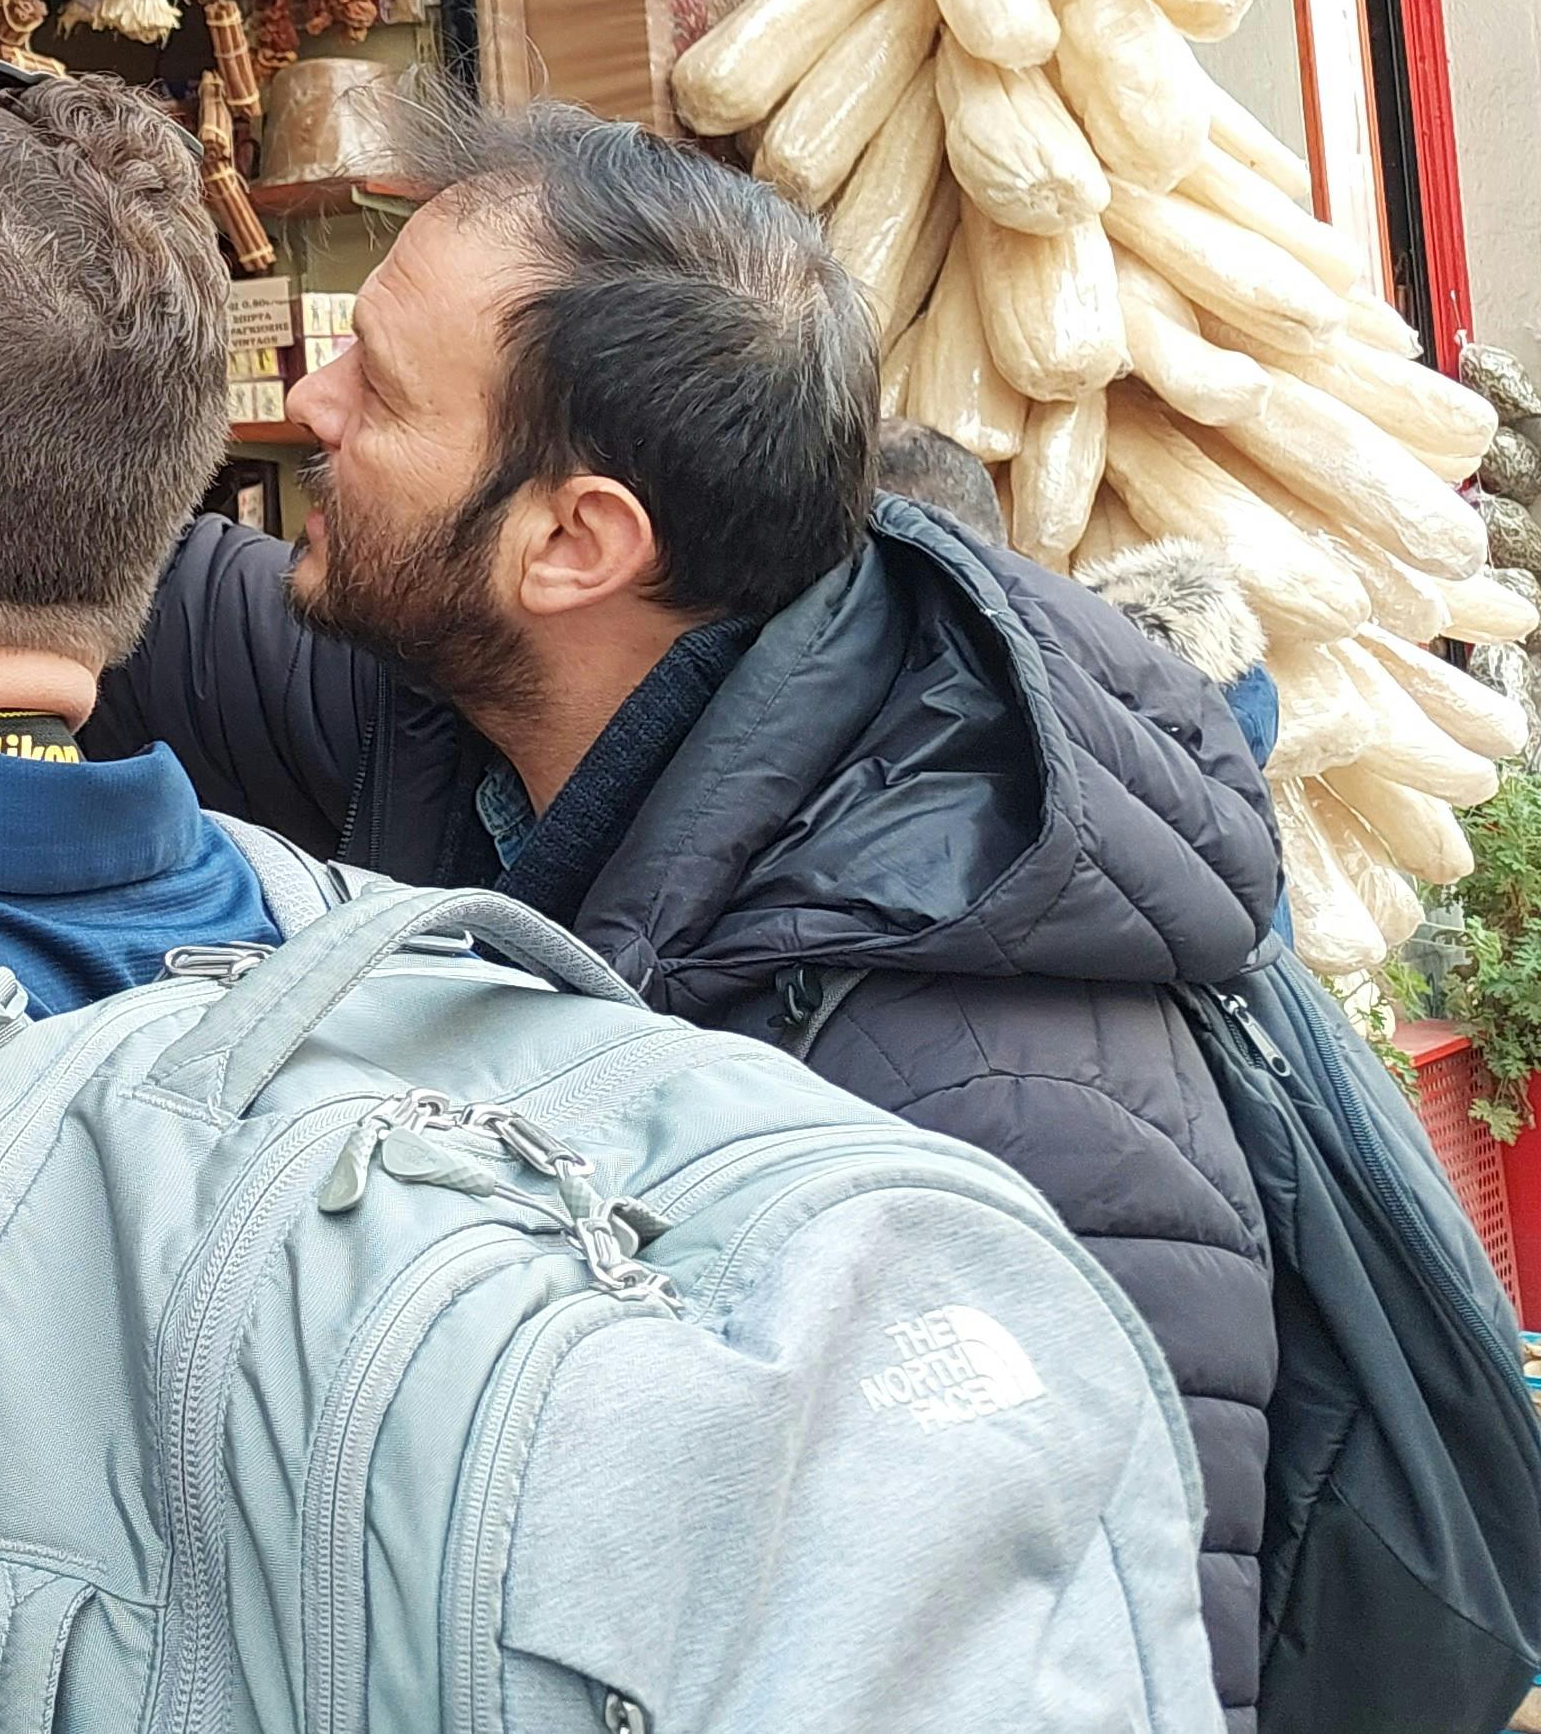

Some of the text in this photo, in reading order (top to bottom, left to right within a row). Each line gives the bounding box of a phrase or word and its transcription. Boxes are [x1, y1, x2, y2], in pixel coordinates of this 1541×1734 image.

[884, 1310, 959, 1361] THE
[859, 1343, 978, 1413] NORTH
[910, 1377, 998, 1436] FACE
